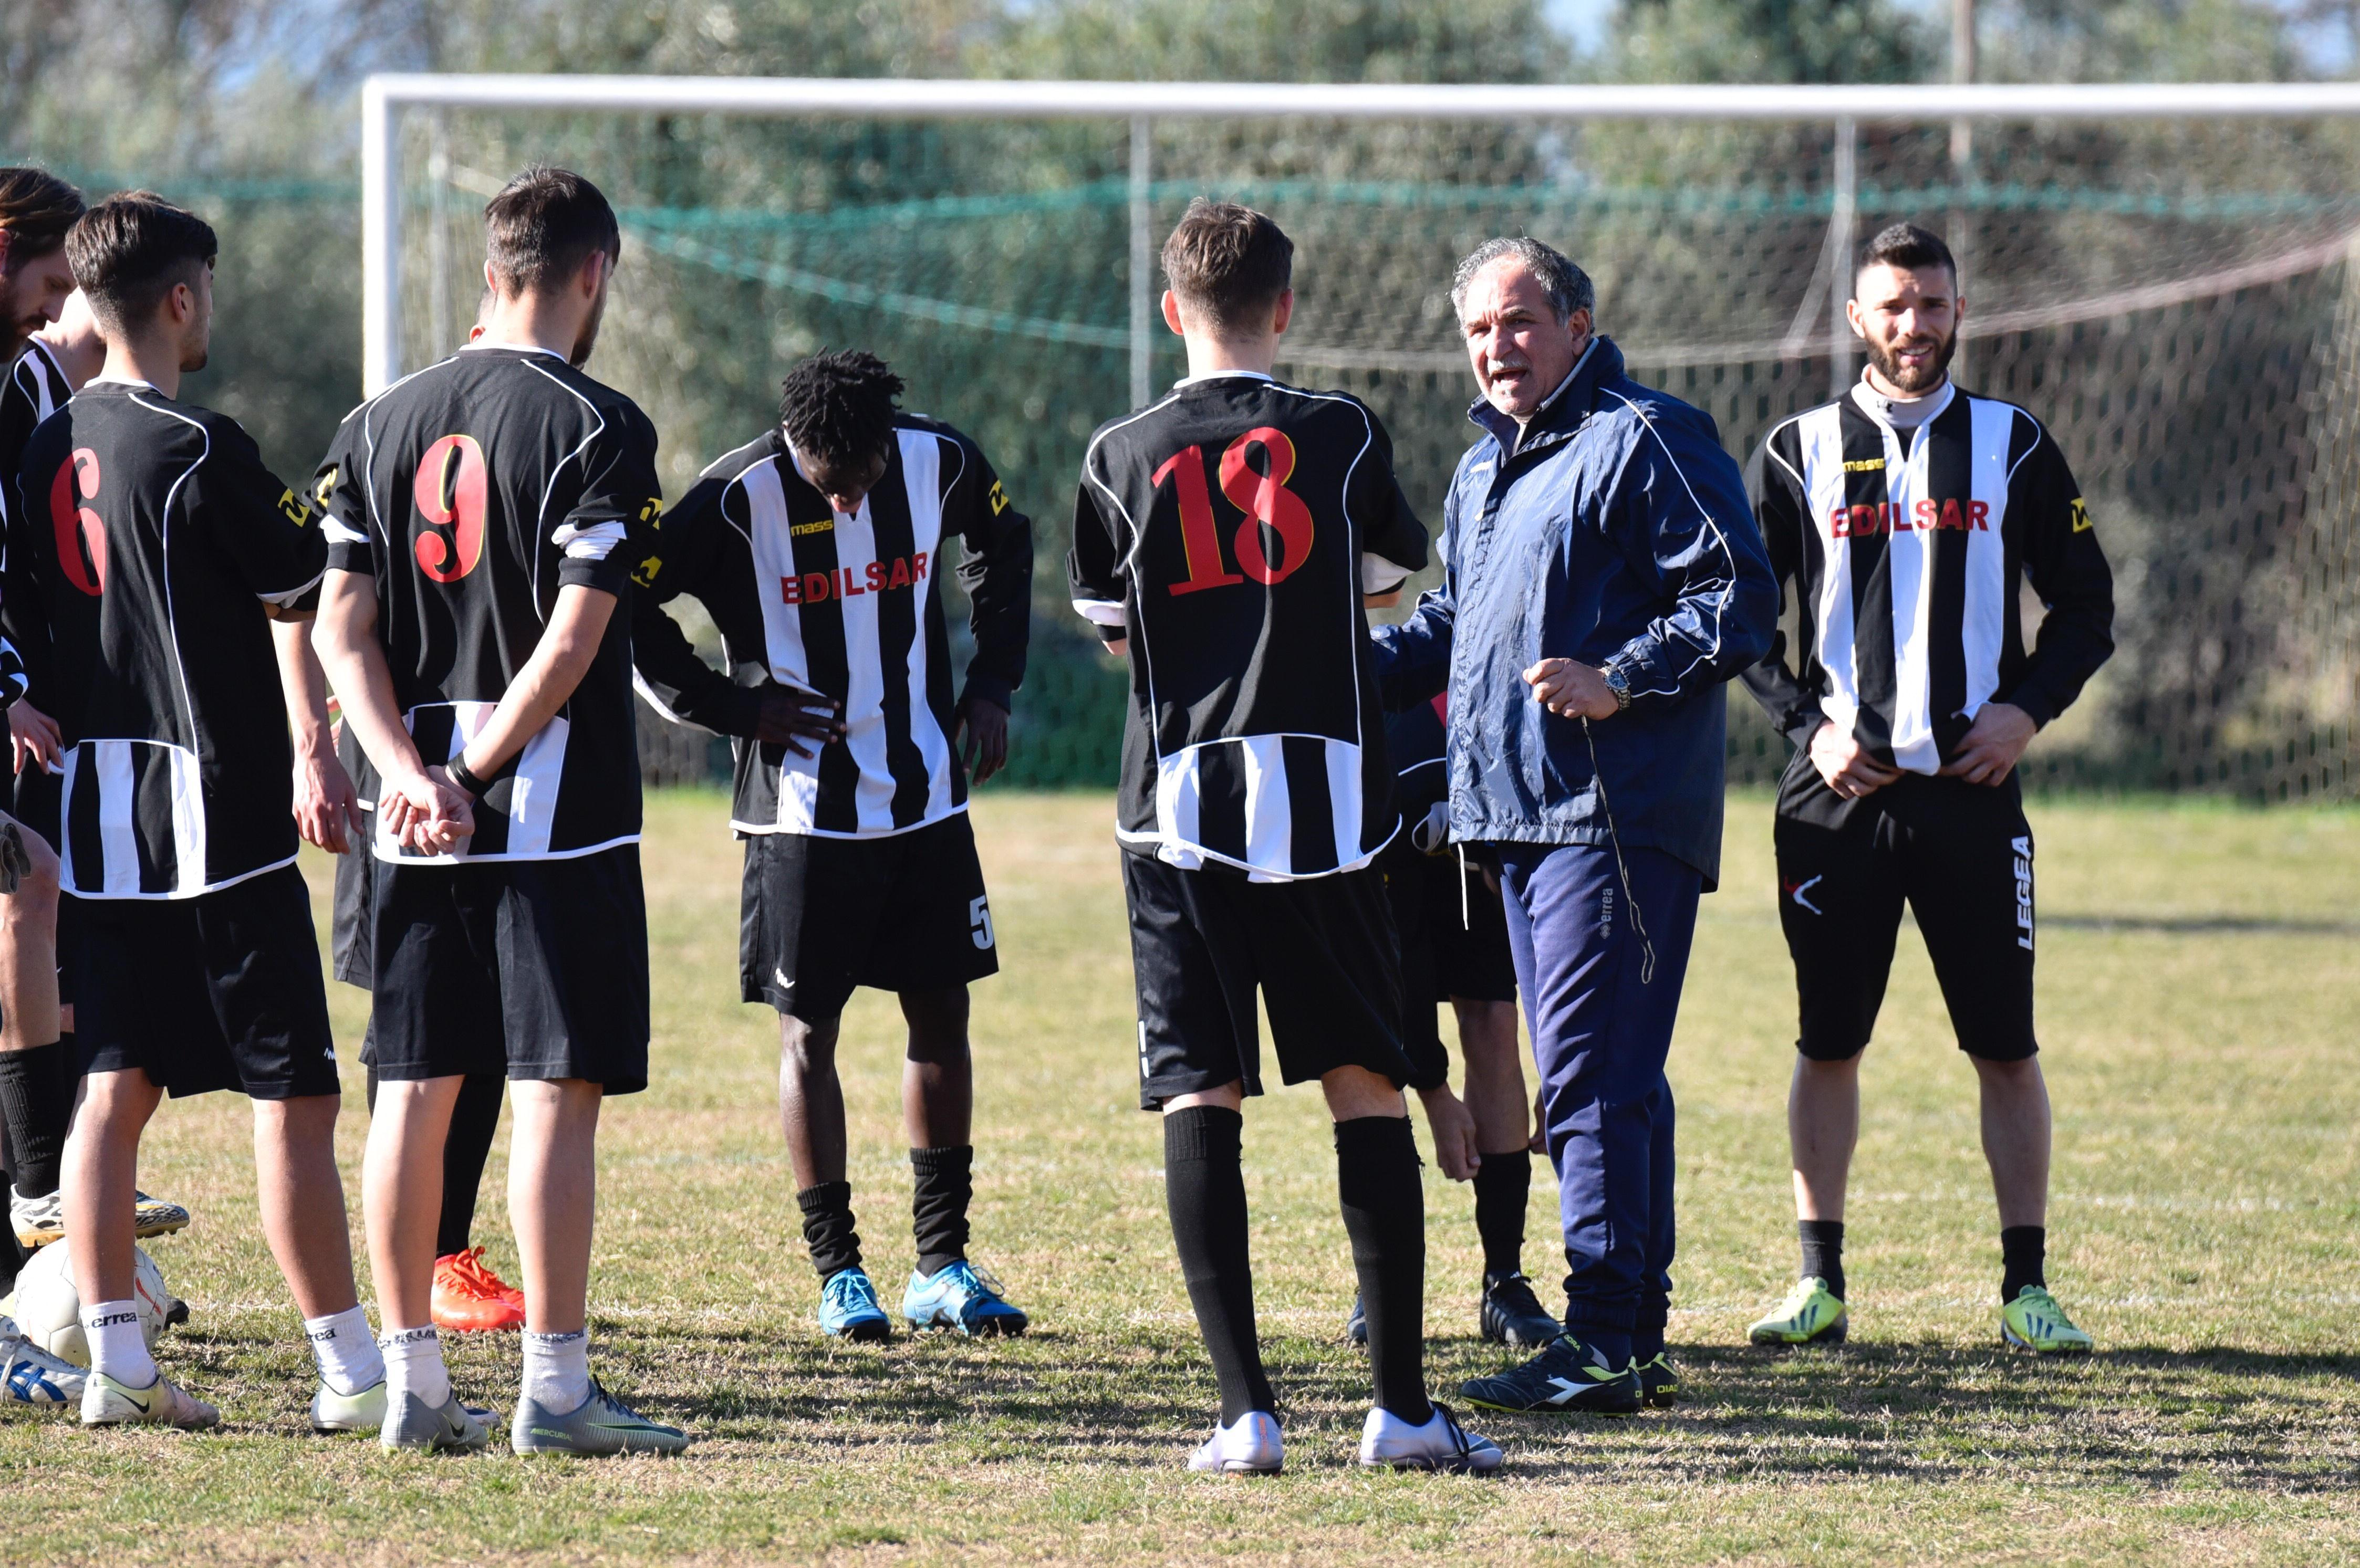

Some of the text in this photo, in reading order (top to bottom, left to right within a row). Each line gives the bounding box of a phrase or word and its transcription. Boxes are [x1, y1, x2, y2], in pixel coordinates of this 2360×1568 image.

[1842, 458, 1886, 473] mass
[50, 447, 106, 597] 6
[415, 434, 487, 583] 9
[790, 519, 834, 537] mass
[1151, 426, 1314, 597] 18
[1830, 498, 1990, 539] EDILSAR
[781, 551, 928, 604] EDILSAR
[1600, 888, 1614, 923] errea
[2011, 835, 2033, 951] LEGEA
[969, 894, 994, 950] 5
[91, 1312, 138, 1329] errea
[529, 1428, 573, 1442] MERCURIAL
